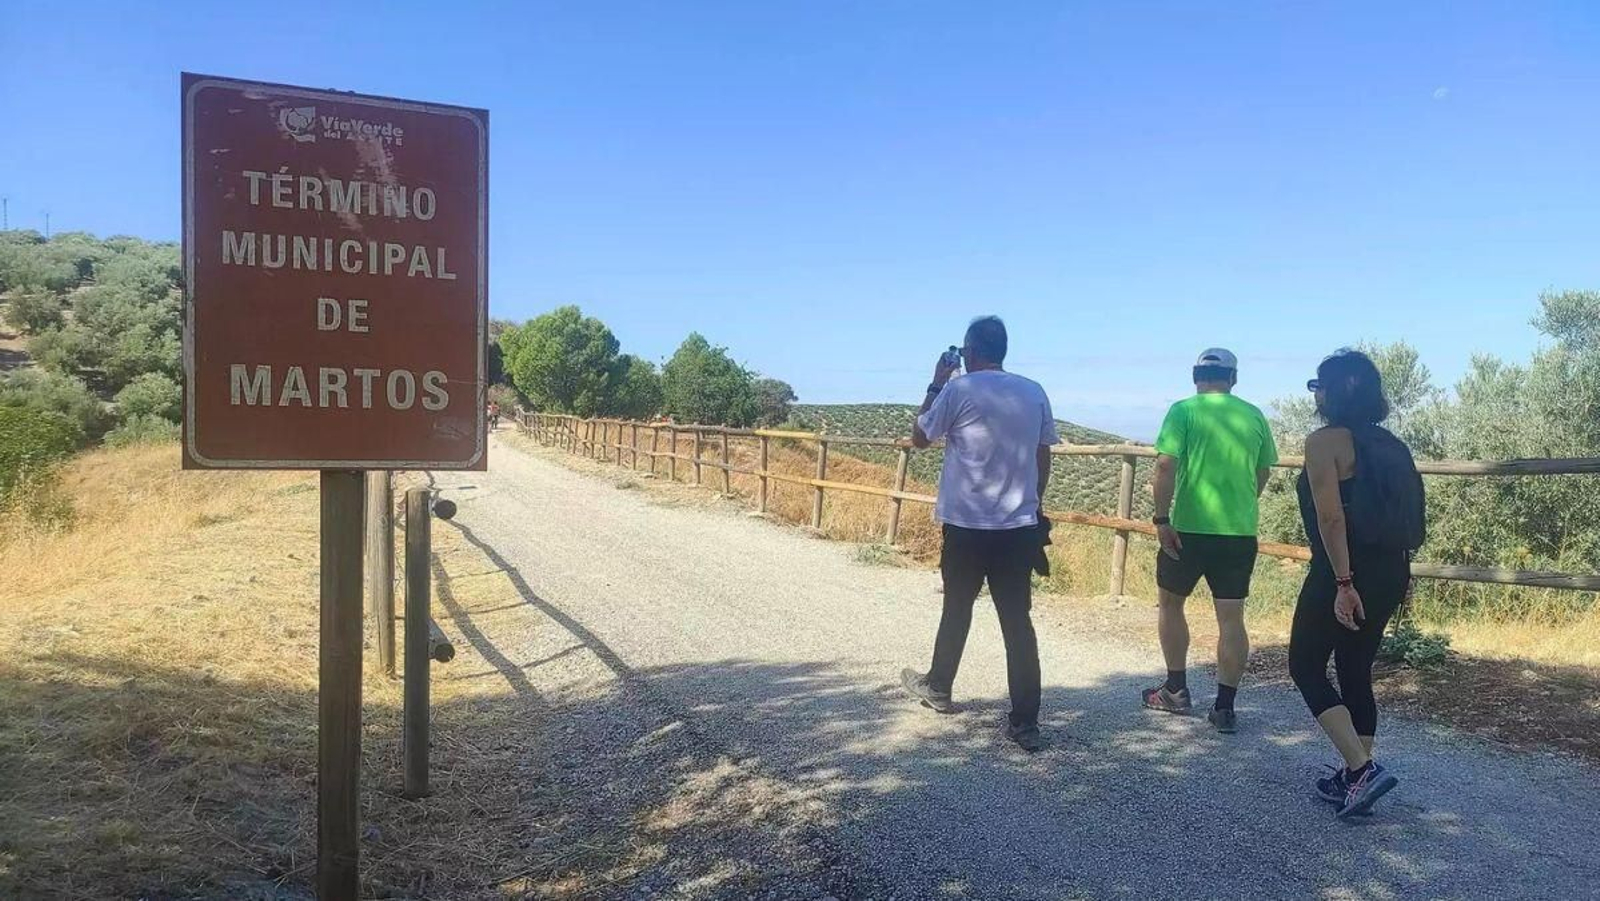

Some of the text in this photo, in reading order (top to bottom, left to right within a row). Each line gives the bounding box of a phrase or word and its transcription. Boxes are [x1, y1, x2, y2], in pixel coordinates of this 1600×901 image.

[324, 130, 341, 139] del
[243, 166, 437, 221] TÉRMINO
[222, 230, 457, 280] MUNICIPAL
[317, 298, 369, 333] DE
[230, 363, 449, 411] MARTOS
